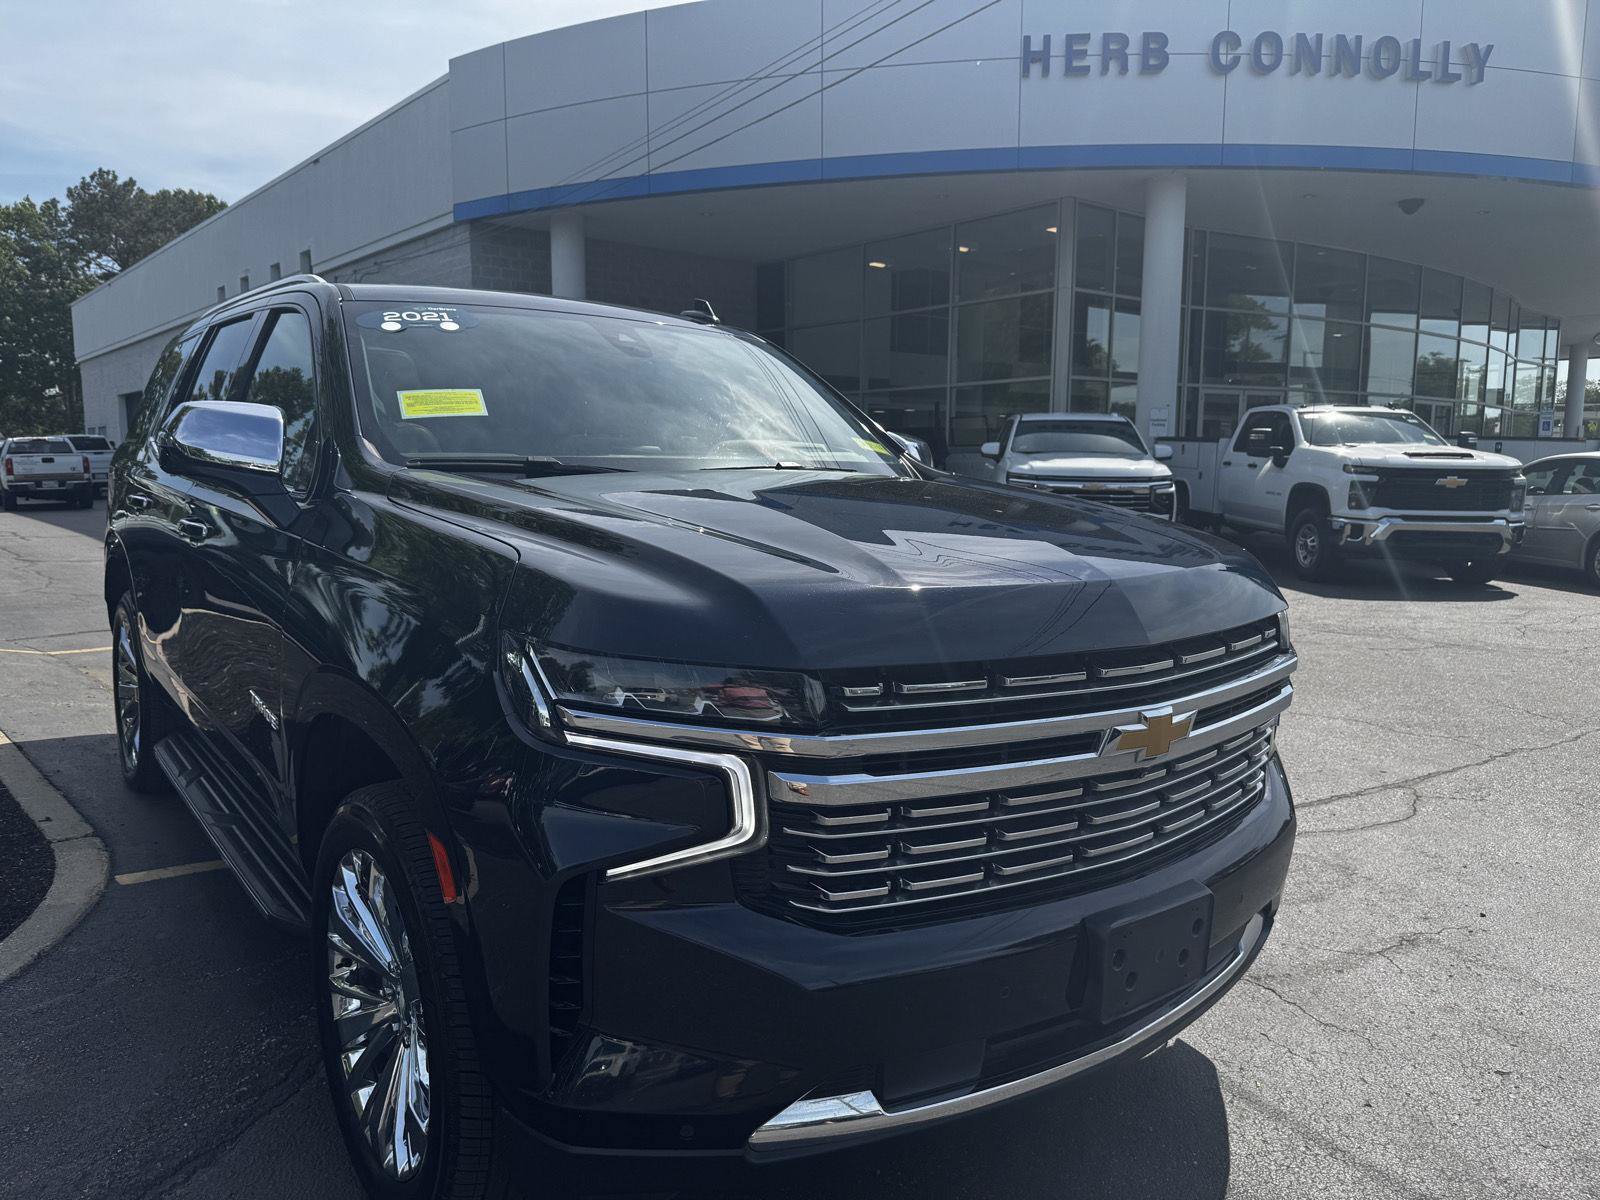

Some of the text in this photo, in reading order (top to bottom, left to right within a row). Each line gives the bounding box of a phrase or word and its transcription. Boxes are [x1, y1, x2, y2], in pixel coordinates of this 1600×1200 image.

[1022, 30, 1494, 85] HERB CONNOLLY
[382, 311, 453, 322] 2021
